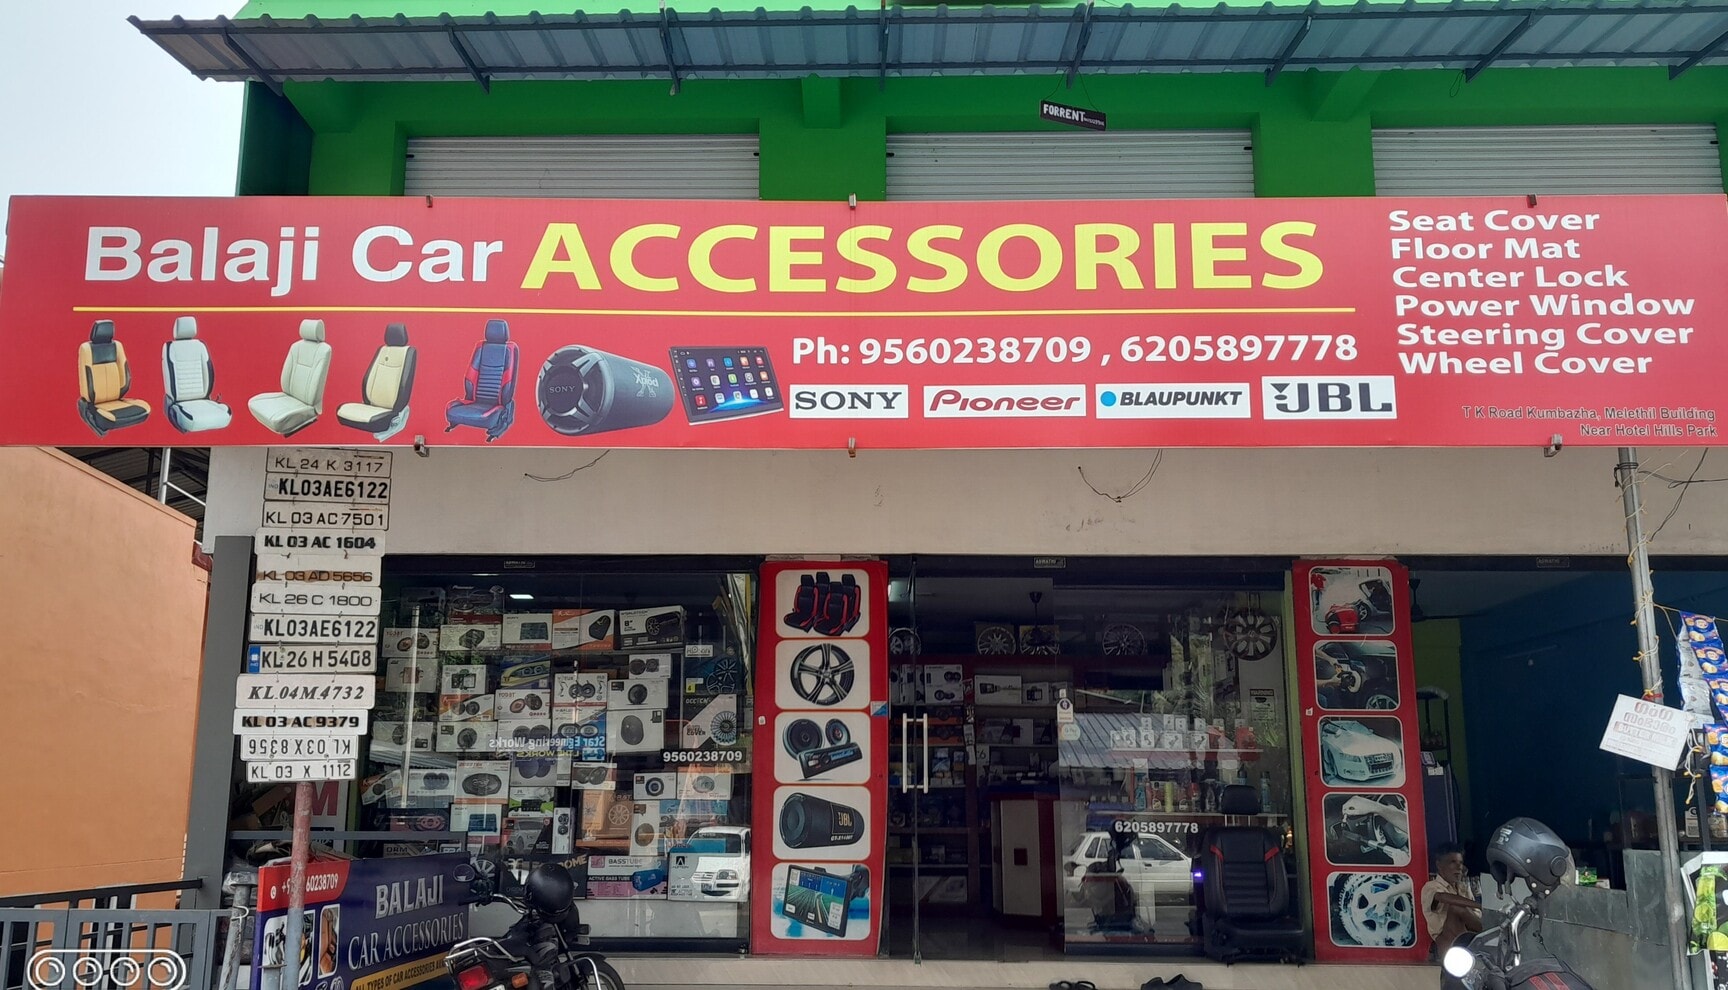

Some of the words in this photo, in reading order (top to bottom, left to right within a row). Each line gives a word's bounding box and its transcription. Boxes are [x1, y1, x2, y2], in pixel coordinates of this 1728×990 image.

[1389, 210, 1474, 231] Seat
[1484, 209, 1600, 230] Cover
[1392, 237, 1493, 259] Floor
[1505, 237, 1581, 259] Mat
[85, 226, 318, 296] Balaji
[352, 226, 502, 282] Car
[520, 221, 1323, 293] ACCESSORIES
[1393, 266, 1524, 288] Center
[1536, 264, 1629, 287] Lock
[1396, 295, 1519, 316] Power
[1529, 293, 1695, 315] Window
[1398, 323, 1565, 350] Steering
[1577, 323, 1694, 344] Cover
[792, 337, 850, 364] Ph:
[859, 337, 1090, 364] 9560238709
[1121, 335, 1358, 362] 6205897778
[1399, 351, 1523, 374] Wheel
[1535, 351, 1652, 373] Cover
[549, 385, 576, 394] SONY
[1120, 390, 1243, 407] BLAUPUNKT
[1272, 381, 1393, 414] JBL
[795, 390, 902, 410] SONY
[929, 389, 1081, 412] Pioneer
[1463, 406, 1471, 419] T
[1475, 406, 1484, 419] K
[1489, 406, 1522, 419] Road
[1527, 406, 1600, 421] Kumbazha,
[1605, 407, 1656, 419] Melethil
[1661, 408, 1716, 422] Building
[1580, 424, 1611, 436] Near
[1616, 424, 1649, 436] Hotel
[1654, 424, 1682, 436] Hills
[1688, 425, 1717, 437] Park
[275, 457, 296, 469] KL
[300, 459, 319, 470] 24
[327, 460, 337, 471] K
[344, 460, 383, 473] 3117
[278, 478, 388, 499] KL03AE6122
[266, 511, 287, 524] KL
[291, 512, 312, 524] 03
[317, 513, 338, 525] AC
[341, 513, 383, 526] 7501
[264, 535, 283, 548] KL
[287, 535, 308, 548] 03
[311, 536, 331, 548] AC
[336, 537, 376, 549] 1604
[263, 570, 282, 581] KL
[285, 571, 305, 582] 03
[307, 571, 330, 582] AD
[333, 571, 373, 582] 5656
[259, 593, 281, 604] KL
[285, 594, 307, 605] 26
[312, 595, 324, 606] C
[329, 595, 373, 607] 1800
[263, 618, 376, 638] KL03AE6122
[262, 651, 283, 668] KL
[286, 651, 307, 668] 26
[313, 651, 322, 667] H
[328, 650, 371, 668] 5408
[242, 716, 262, 727] KL
[265, 717, 287, 727] 03
[291, 717, 312, 727] AC
[316, 716, 360, 727] 9379
[663, 751, 743, 762] 9560238709
[251, 766, 268, 778] KL
[275, 766, 292, 778] 03
[303, 766, 311, 777] X
[323, 764, 351, 777] 1112
[1115, 821, 1199, 833] 6205897778
[375, 874, 445, 919] BALAJI
[348, 936, 381, 970] CAR
[383, 912, 464, 960] ACCESSORIES
[367, 976, 384, 990] TYPES
[385, 974, 393, 986] OF
[393, 972, 404, 984] CAR
[404, 961, 436, 981] ACCESSORIES
